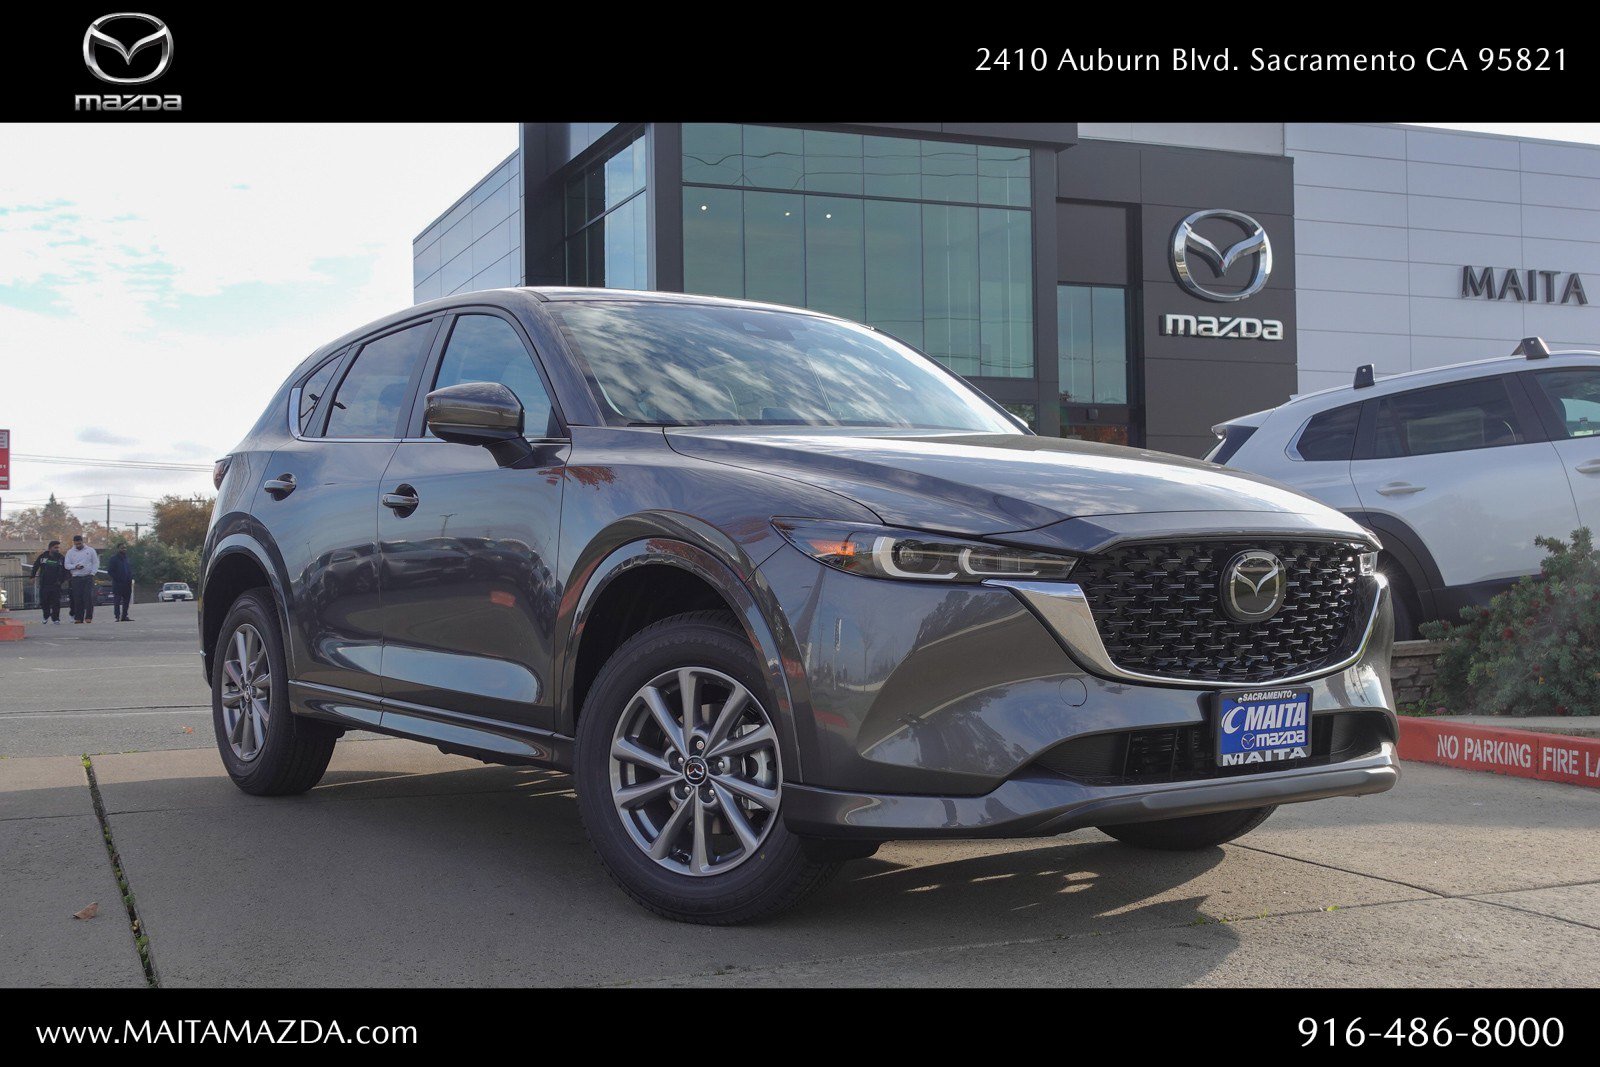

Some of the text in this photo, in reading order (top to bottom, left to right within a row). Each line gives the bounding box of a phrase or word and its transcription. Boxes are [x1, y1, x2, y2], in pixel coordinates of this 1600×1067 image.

[1462, 265, 1589, 305] MAITA
[1243, 690, 1292, 702] SACRAMENTO
[1222, 747, 1307, 767] MAITA
[1437, 734, 1459, 760] NO
[1464, 737, 1532, 769] PARKING
[1543, 747, 1579, 776] FIRE
